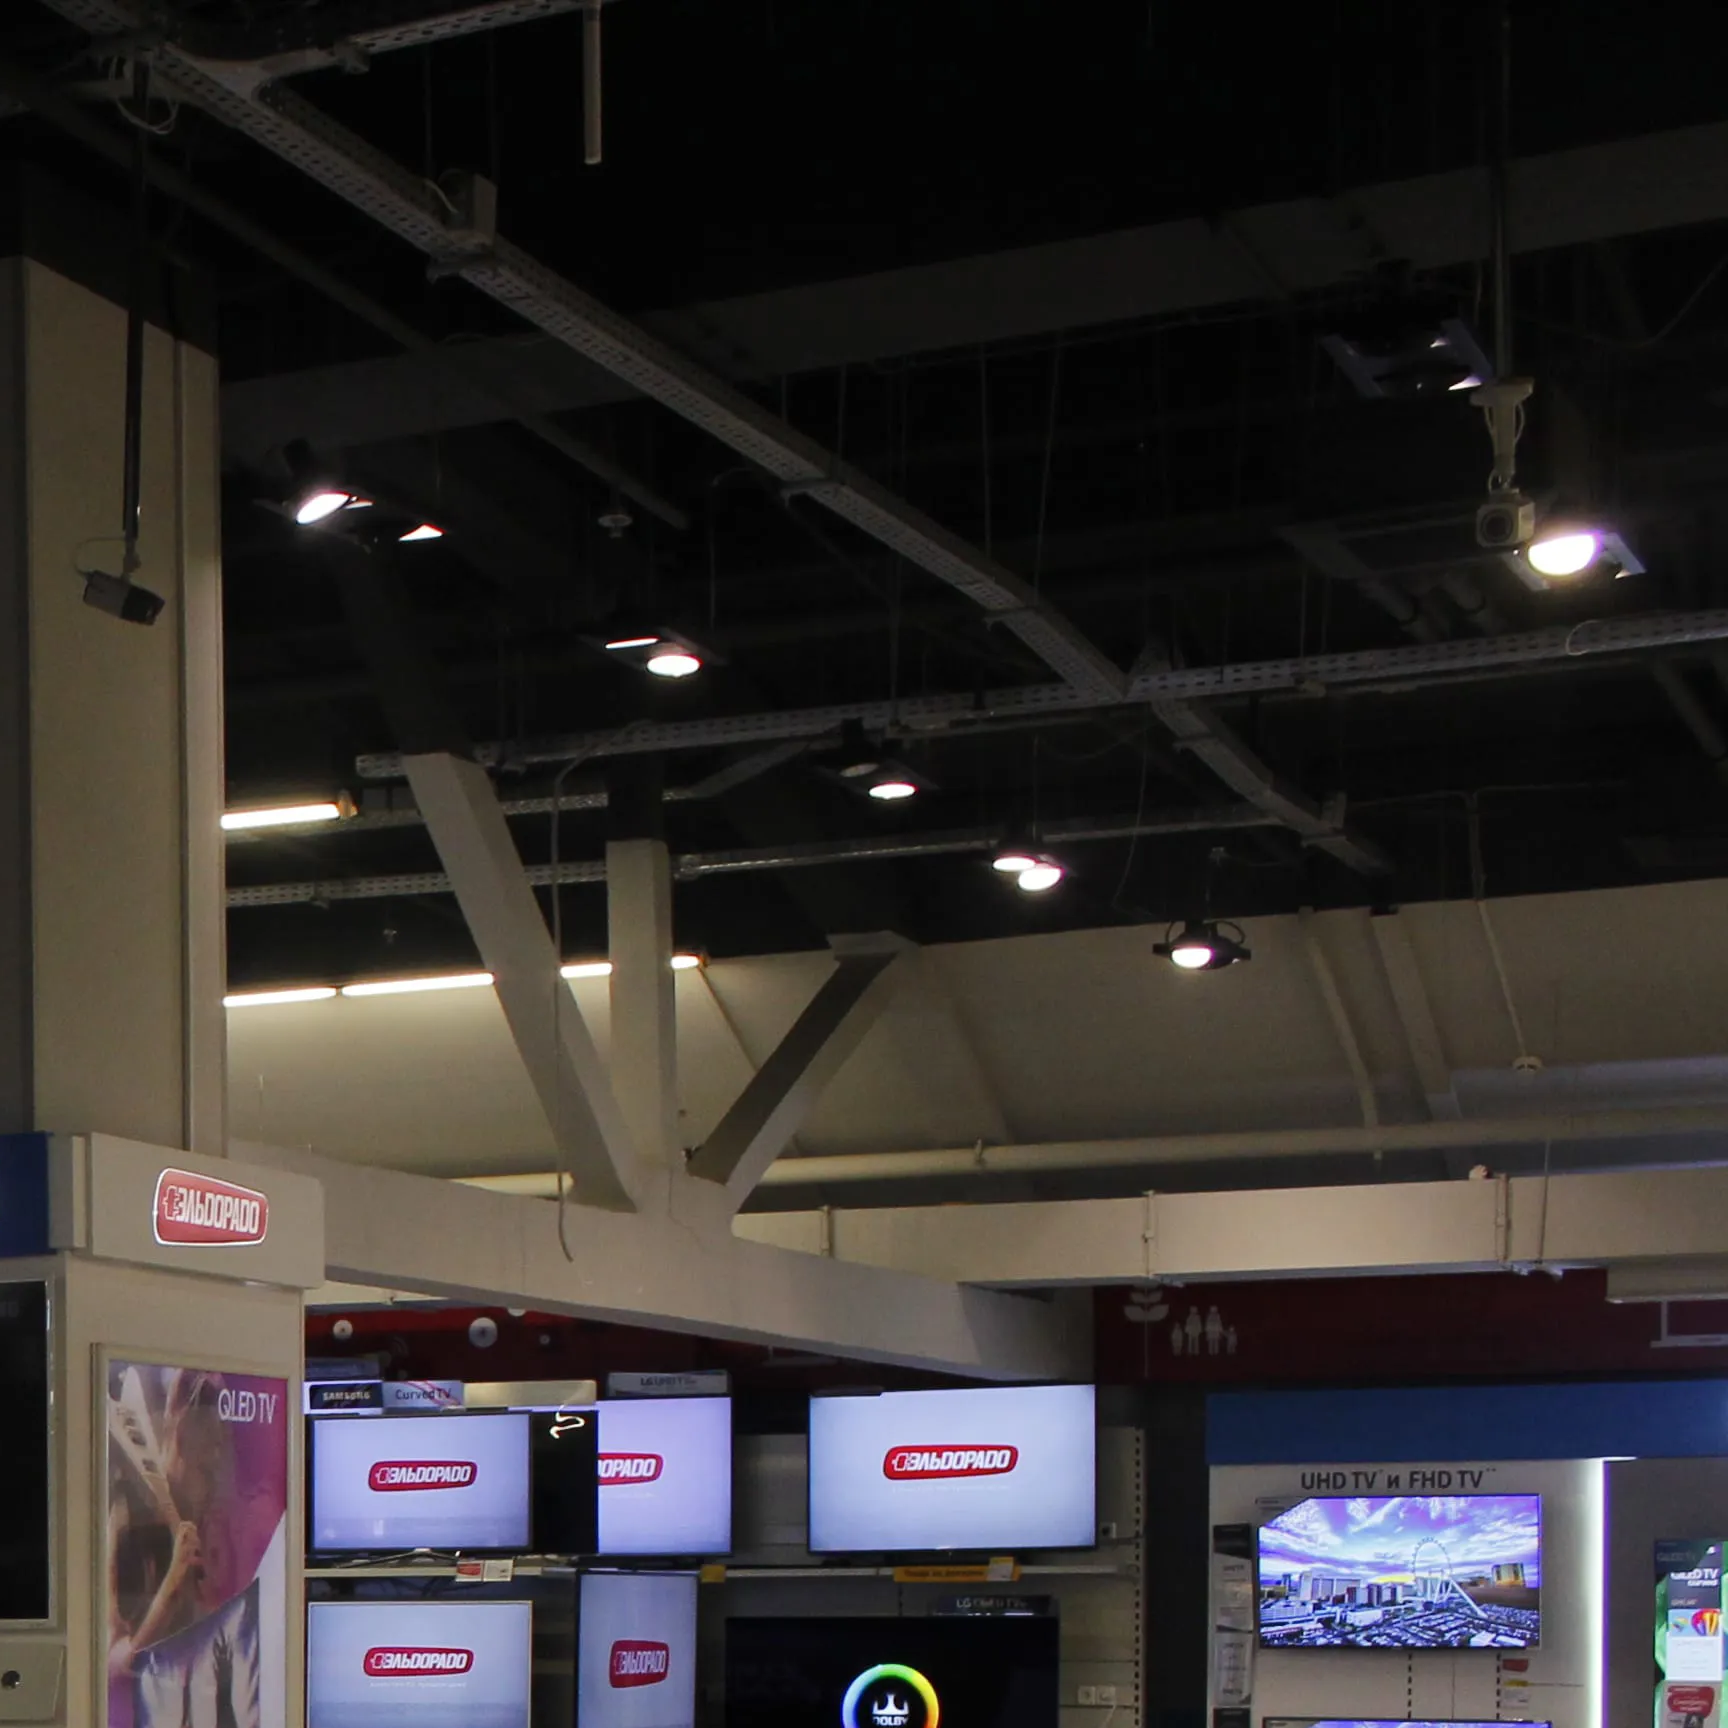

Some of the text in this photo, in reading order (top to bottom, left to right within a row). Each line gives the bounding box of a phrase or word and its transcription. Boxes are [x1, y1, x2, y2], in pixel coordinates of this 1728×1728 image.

[217, 1388, 257, 1422] QLED
[1301, 1472, 1347, 1490] UHD
[1408, 1471, 1453, 1490] FHD
